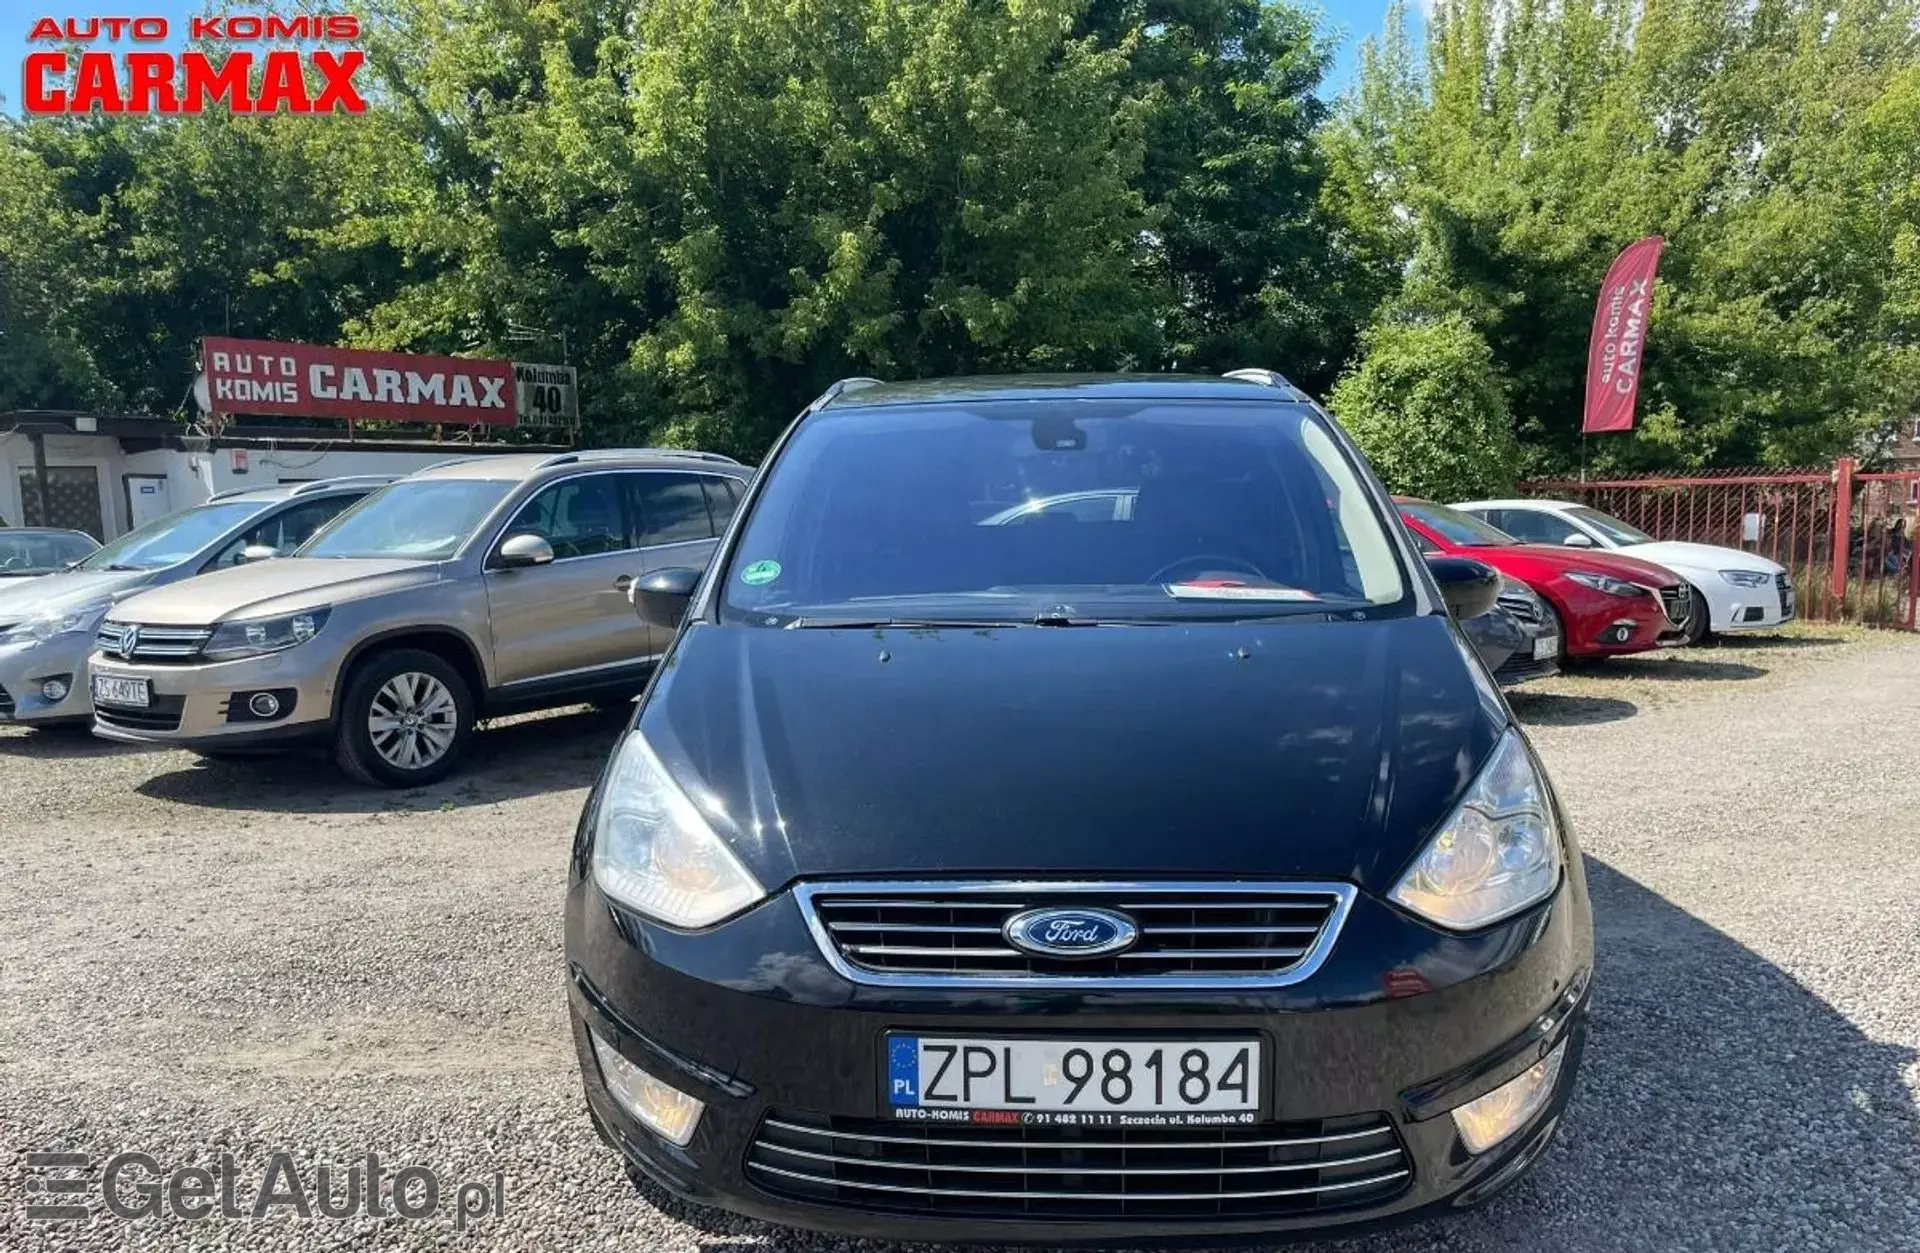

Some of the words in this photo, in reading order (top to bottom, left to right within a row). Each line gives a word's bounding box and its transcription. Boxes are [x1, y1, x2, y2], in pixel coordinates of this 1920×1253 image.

[1616, 279, 1648, 394] CARMAX
[213, 352, 298, 377] AUTO
[1601, 342, 1616, 384] auto
[215, 378, 299, 404] KOMIS
[309, 363, 505, 409] CARMAX
[532, 386, 562, 413] 40
[1045, 919, 1099, 941] Ford
[893, 1079, 915, 1095] PL
[923, 1044, 1036, 1104] ZPL
[1061, 1047, 1249, 1106] 98184
[896, 1108, 970, 1121] AUTO-KOMIS
[972, 1111, 1019, 1124] CARMAX
[1036, 1113, 1050, 1124] 91
[1054, 1113, 1077, 1125] 482
[1082, 1114, 1094, 1124] 11
[1100, 1114, 1112, 1125] 11
[1169, 1114, 1184, 1125] ul.
[1186, 1113, 1236, 1125] Kolumba
[1239, 1112, 1254, 1123] 40
